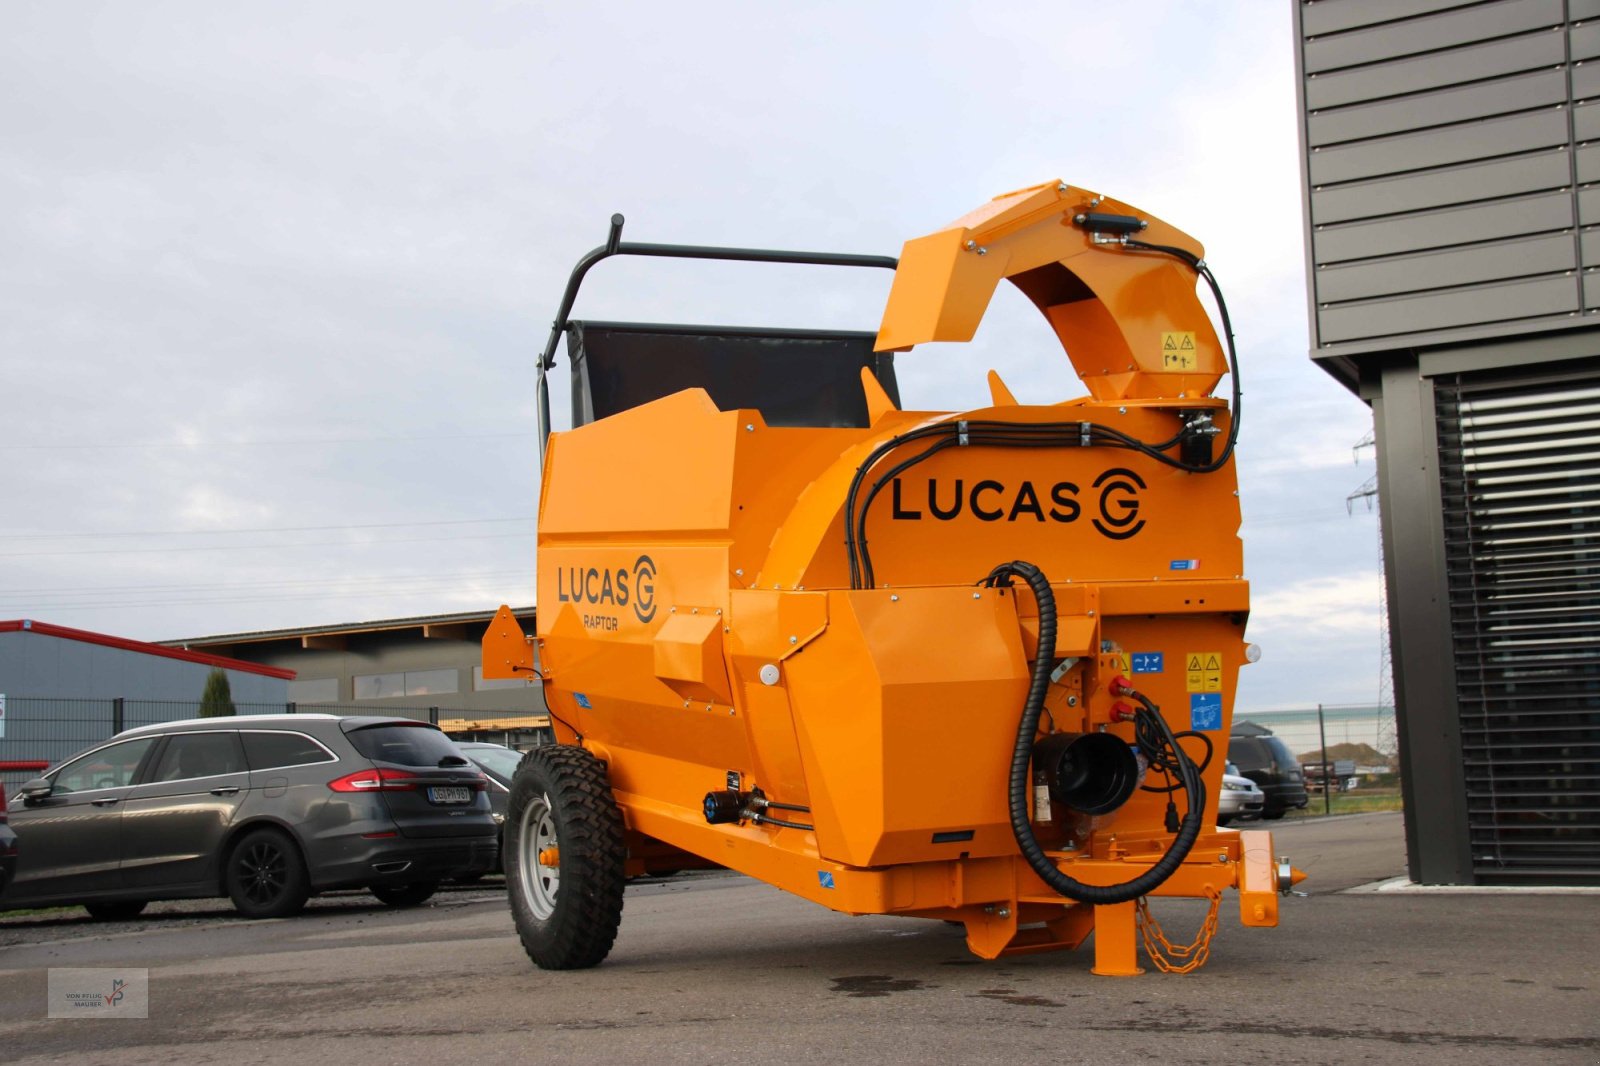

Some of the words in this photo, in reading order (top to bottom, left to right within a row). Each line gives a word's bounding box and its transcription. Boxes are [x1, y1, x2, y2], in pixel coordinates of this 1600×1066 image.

[893, 478, 1081, 523] LUCAS
[558, 567, 629, 606] LUCAS
[583, 614, 618, 631] RAPTOR
